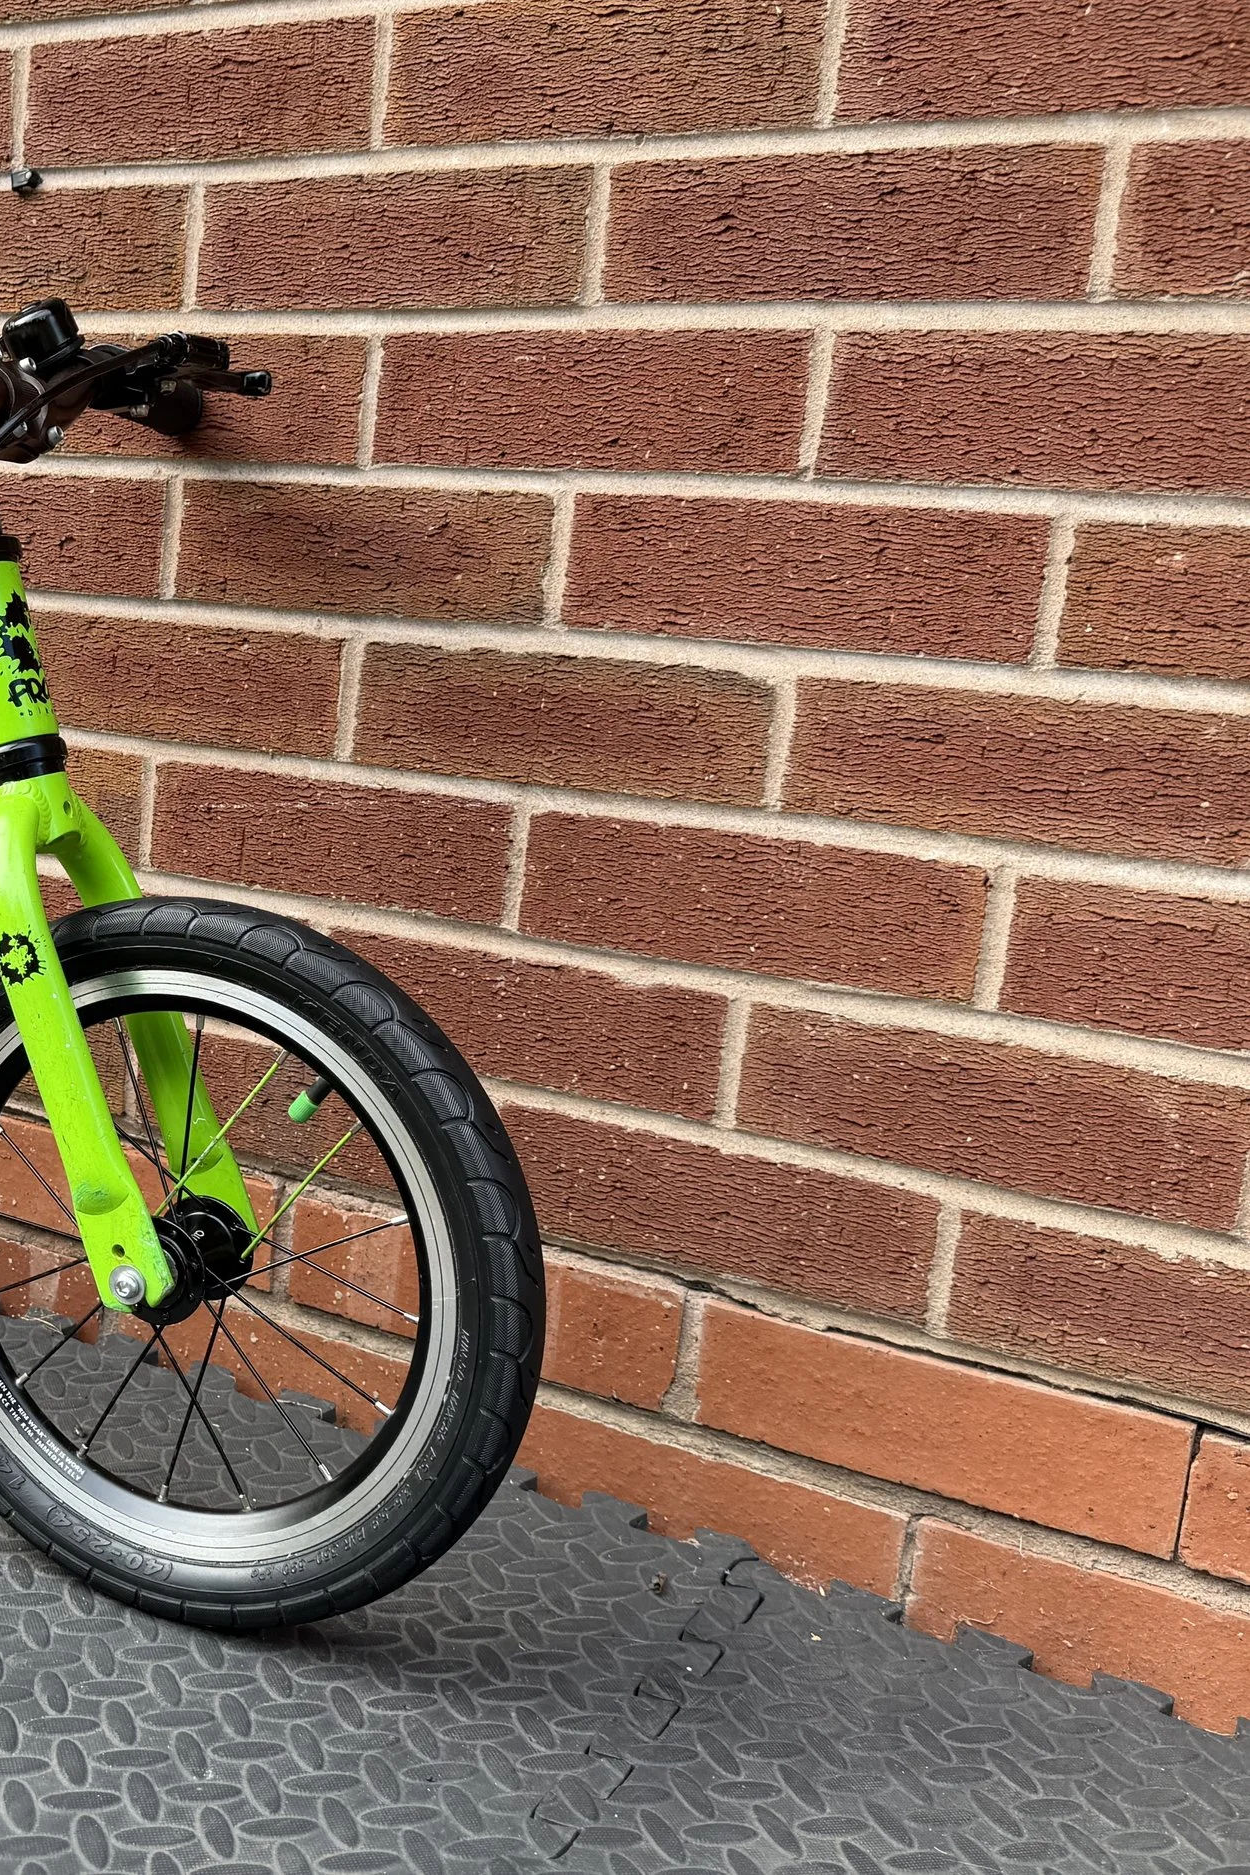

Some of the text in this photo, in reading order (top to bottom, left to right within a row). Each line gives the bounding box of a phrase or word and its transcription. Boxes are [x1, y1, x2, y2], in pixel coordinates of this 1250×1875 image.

[293, 994, 401, 1100] KENDA
[5, 1390, 17, 1405] THE
[45, 1439, 60, 1454] LINE
[58, 1450, 67, 1459] IS
[65, 1457, 86, 1476] WORN
[8, 1407, 22, 1422] THE
[20, 1422, 35, 1438] RIM
[34, 1438, 82, 1482] IMMEDIATELY
[46, 1505, 174, 1581] (40-254)
